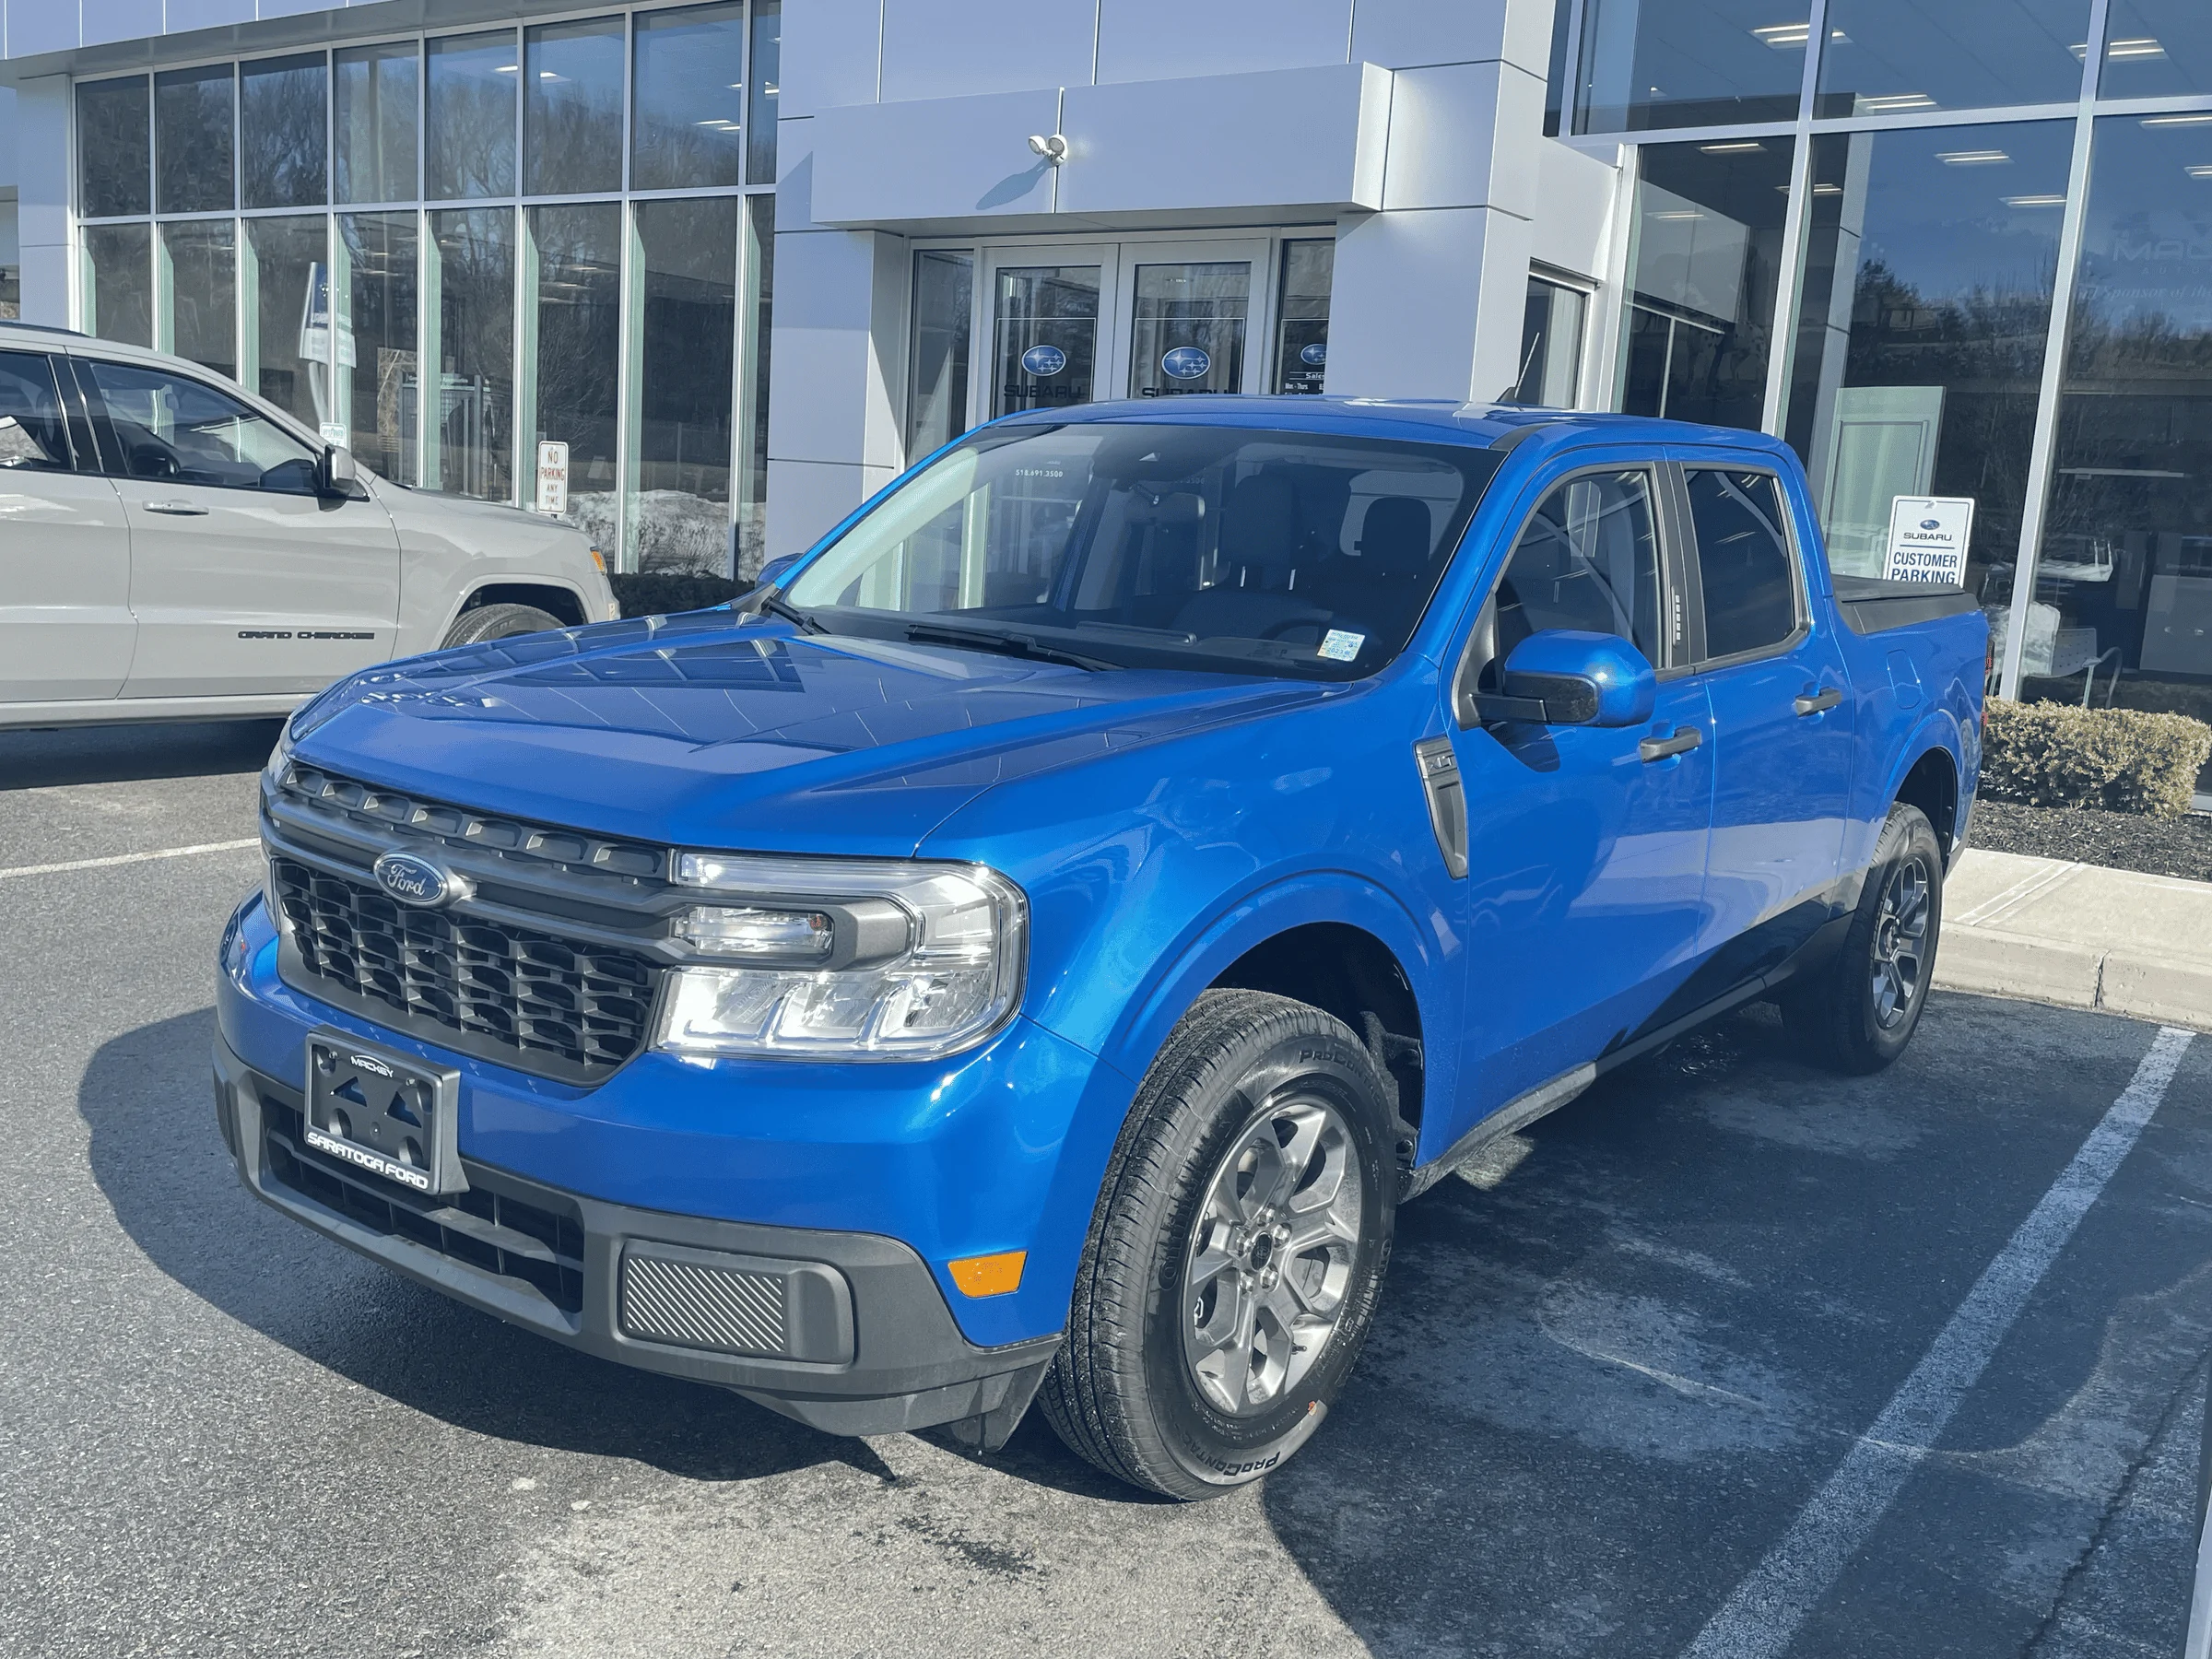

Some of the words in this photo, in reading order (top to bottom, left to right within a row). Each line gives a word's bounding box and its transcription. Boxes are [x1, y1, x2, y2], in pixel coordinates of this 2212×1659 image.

[1004, 384, 1082, 398] SUBARU
[547, 451, 559, 464] NO
[541, 466, 565, 481] PARKING
[1015, 468, 1064, 478] 518.691.3500
[547, 484, 559, 492] ANY
[545, 495, 559, 505] TIME
[1903, 532, 1953, 542] SUBARU
[1893, 551, 1958, 569] CUSTOMER
[1890, 568, 1956, 584] PARKING
[238, 630, 292, 639] GRAND
[297, 631, 375, 640] CHEROKEE
[387, 863, 428, 896] Ford
[350, 1055, 394, 1077] MACKEY
[307, 1132, 385, 1172] SARATOGA
[384, 1163, 429, 1190] FORD
